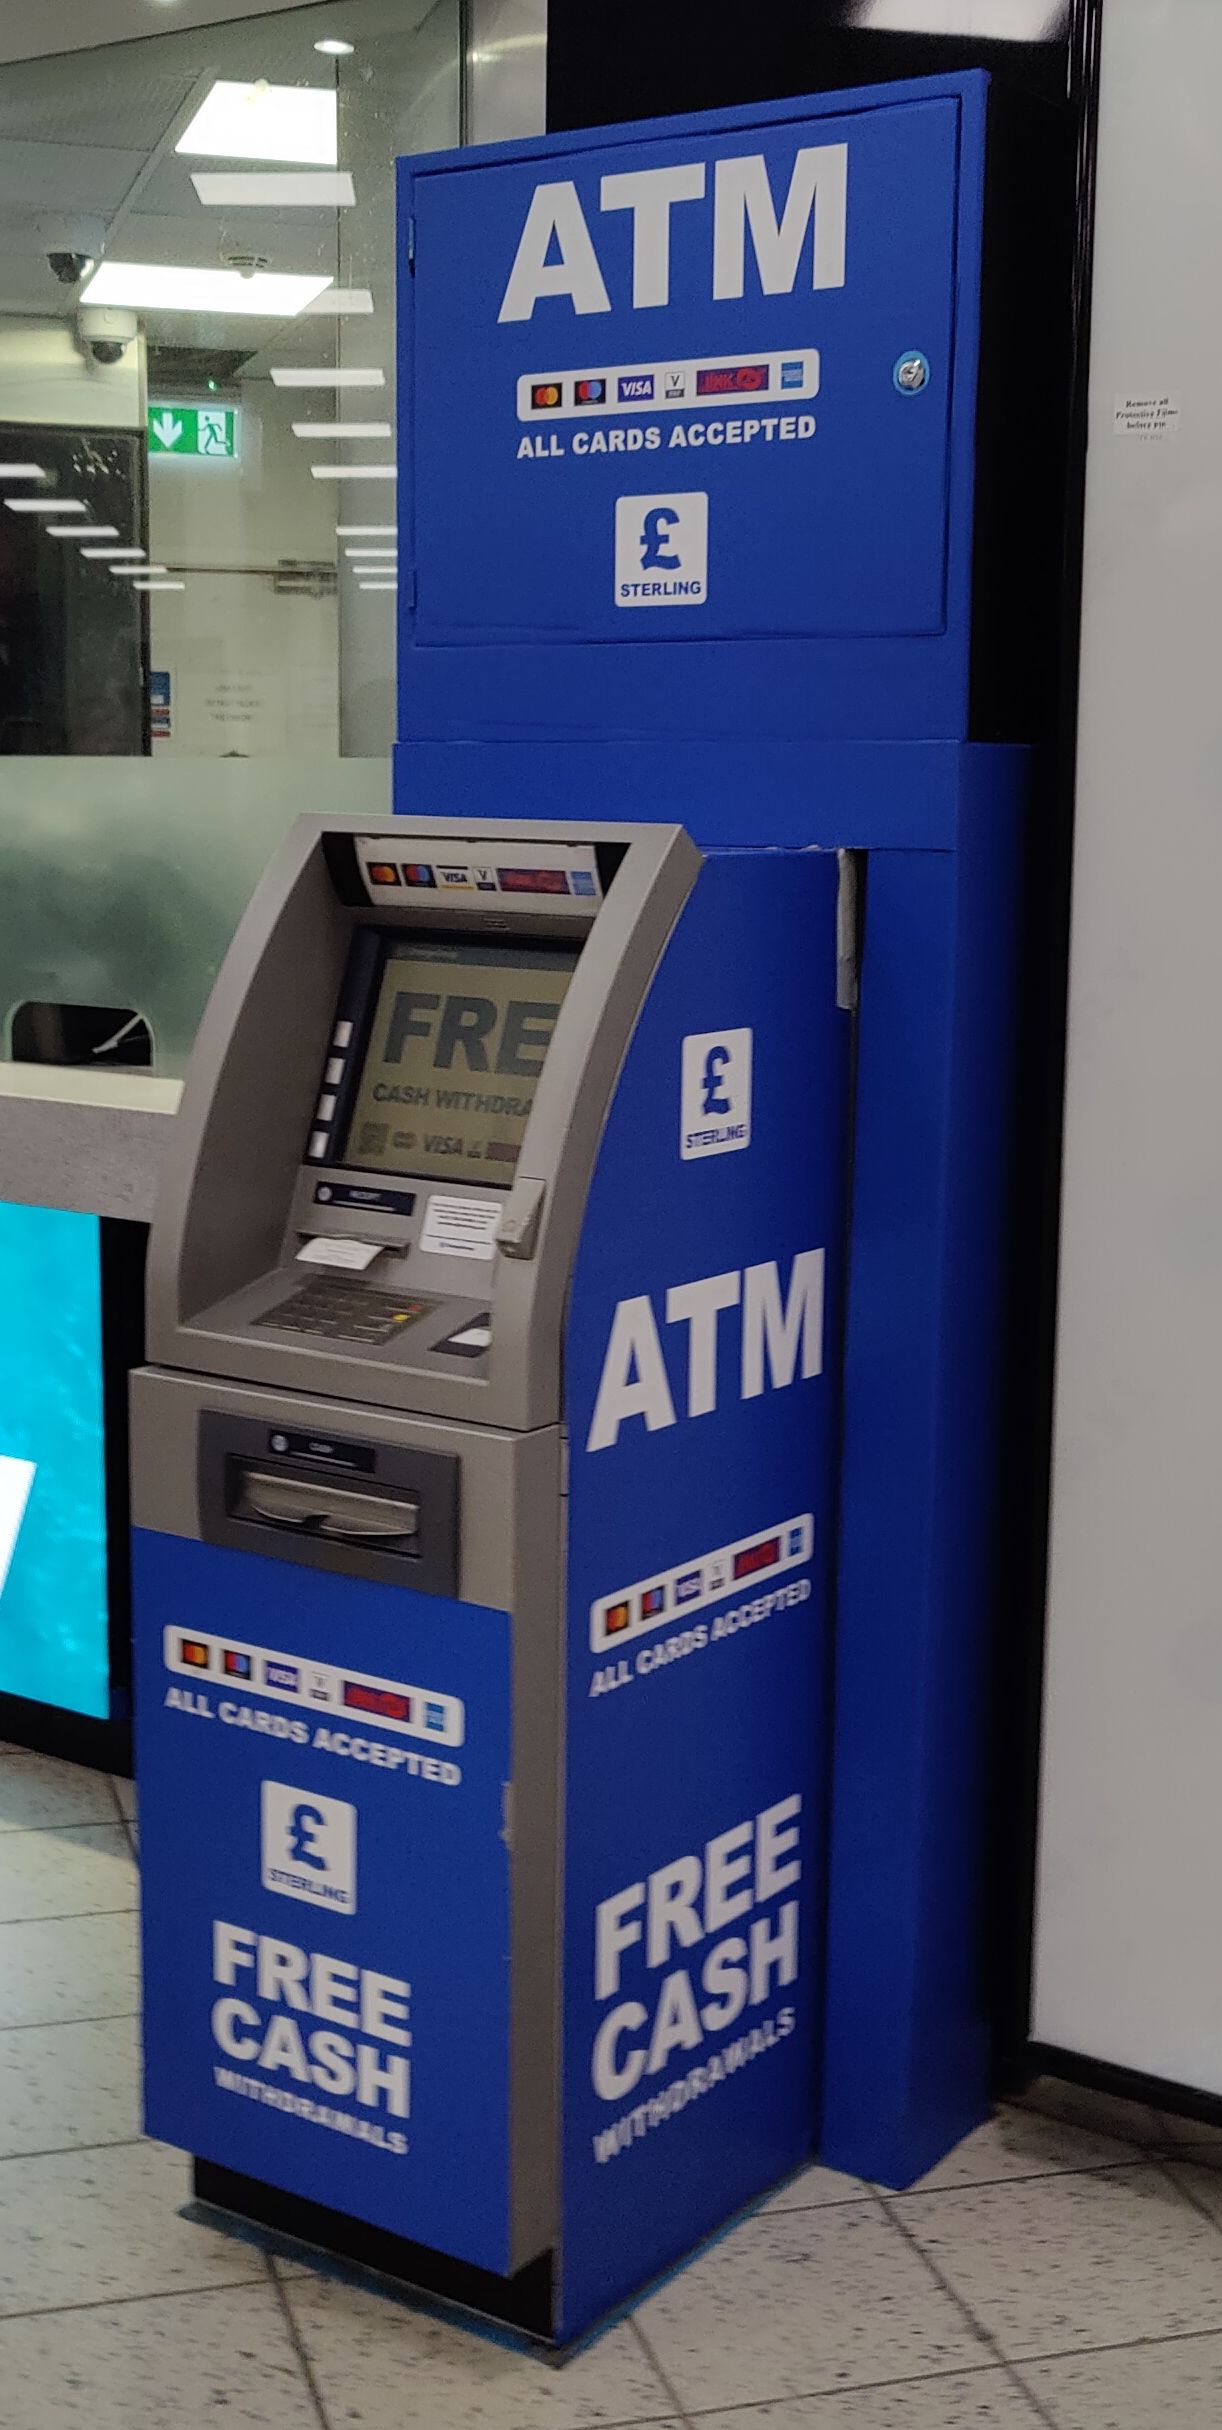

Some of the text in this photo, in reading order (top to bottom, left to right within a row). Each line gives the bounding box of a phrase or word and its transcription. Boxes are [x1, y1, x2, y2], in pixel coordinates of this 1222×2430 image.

[498, 143, 848, 323] ATM
[622, 381, 652, 396] VISA
[517, 416, 816, 458] ALL CARDS ACCEPTED
[640, 507, 681, 571] £
[620, 581, 701, 597] STERLING
[443, 872, 468, 883] VISA
[373, 1083, 431, 1105] CASH
[702, 1046, 731, 1115] £
[423, 1133, 464, 1155] VISA
[685, 1124, 747, 1149] STERLING
[586, 1248, 825, 1452] ATM
[588, 1578, 811, 1697] ALL CARDS ACCEPTED
[164, 1687, 214, 1718] ALL
[218, 1702, 309, 1743] CARDS
[312, 1729, 462, 1786] ACCEPTED
[286, 1804, 327, 1871] £
[270, 1869, 349, 1903] STERLING
[594, 1793, 801, 2000] FREE
[213, 1920, 412, 2047] FREE
[592, 1900, 798, 2100] CASH
[211, 1998, 411, 2119] CASH
[593, 2007, 796, 2163] WITHDRAWALS
[214, 2066, 409, 2155] WITHDRAWALS
